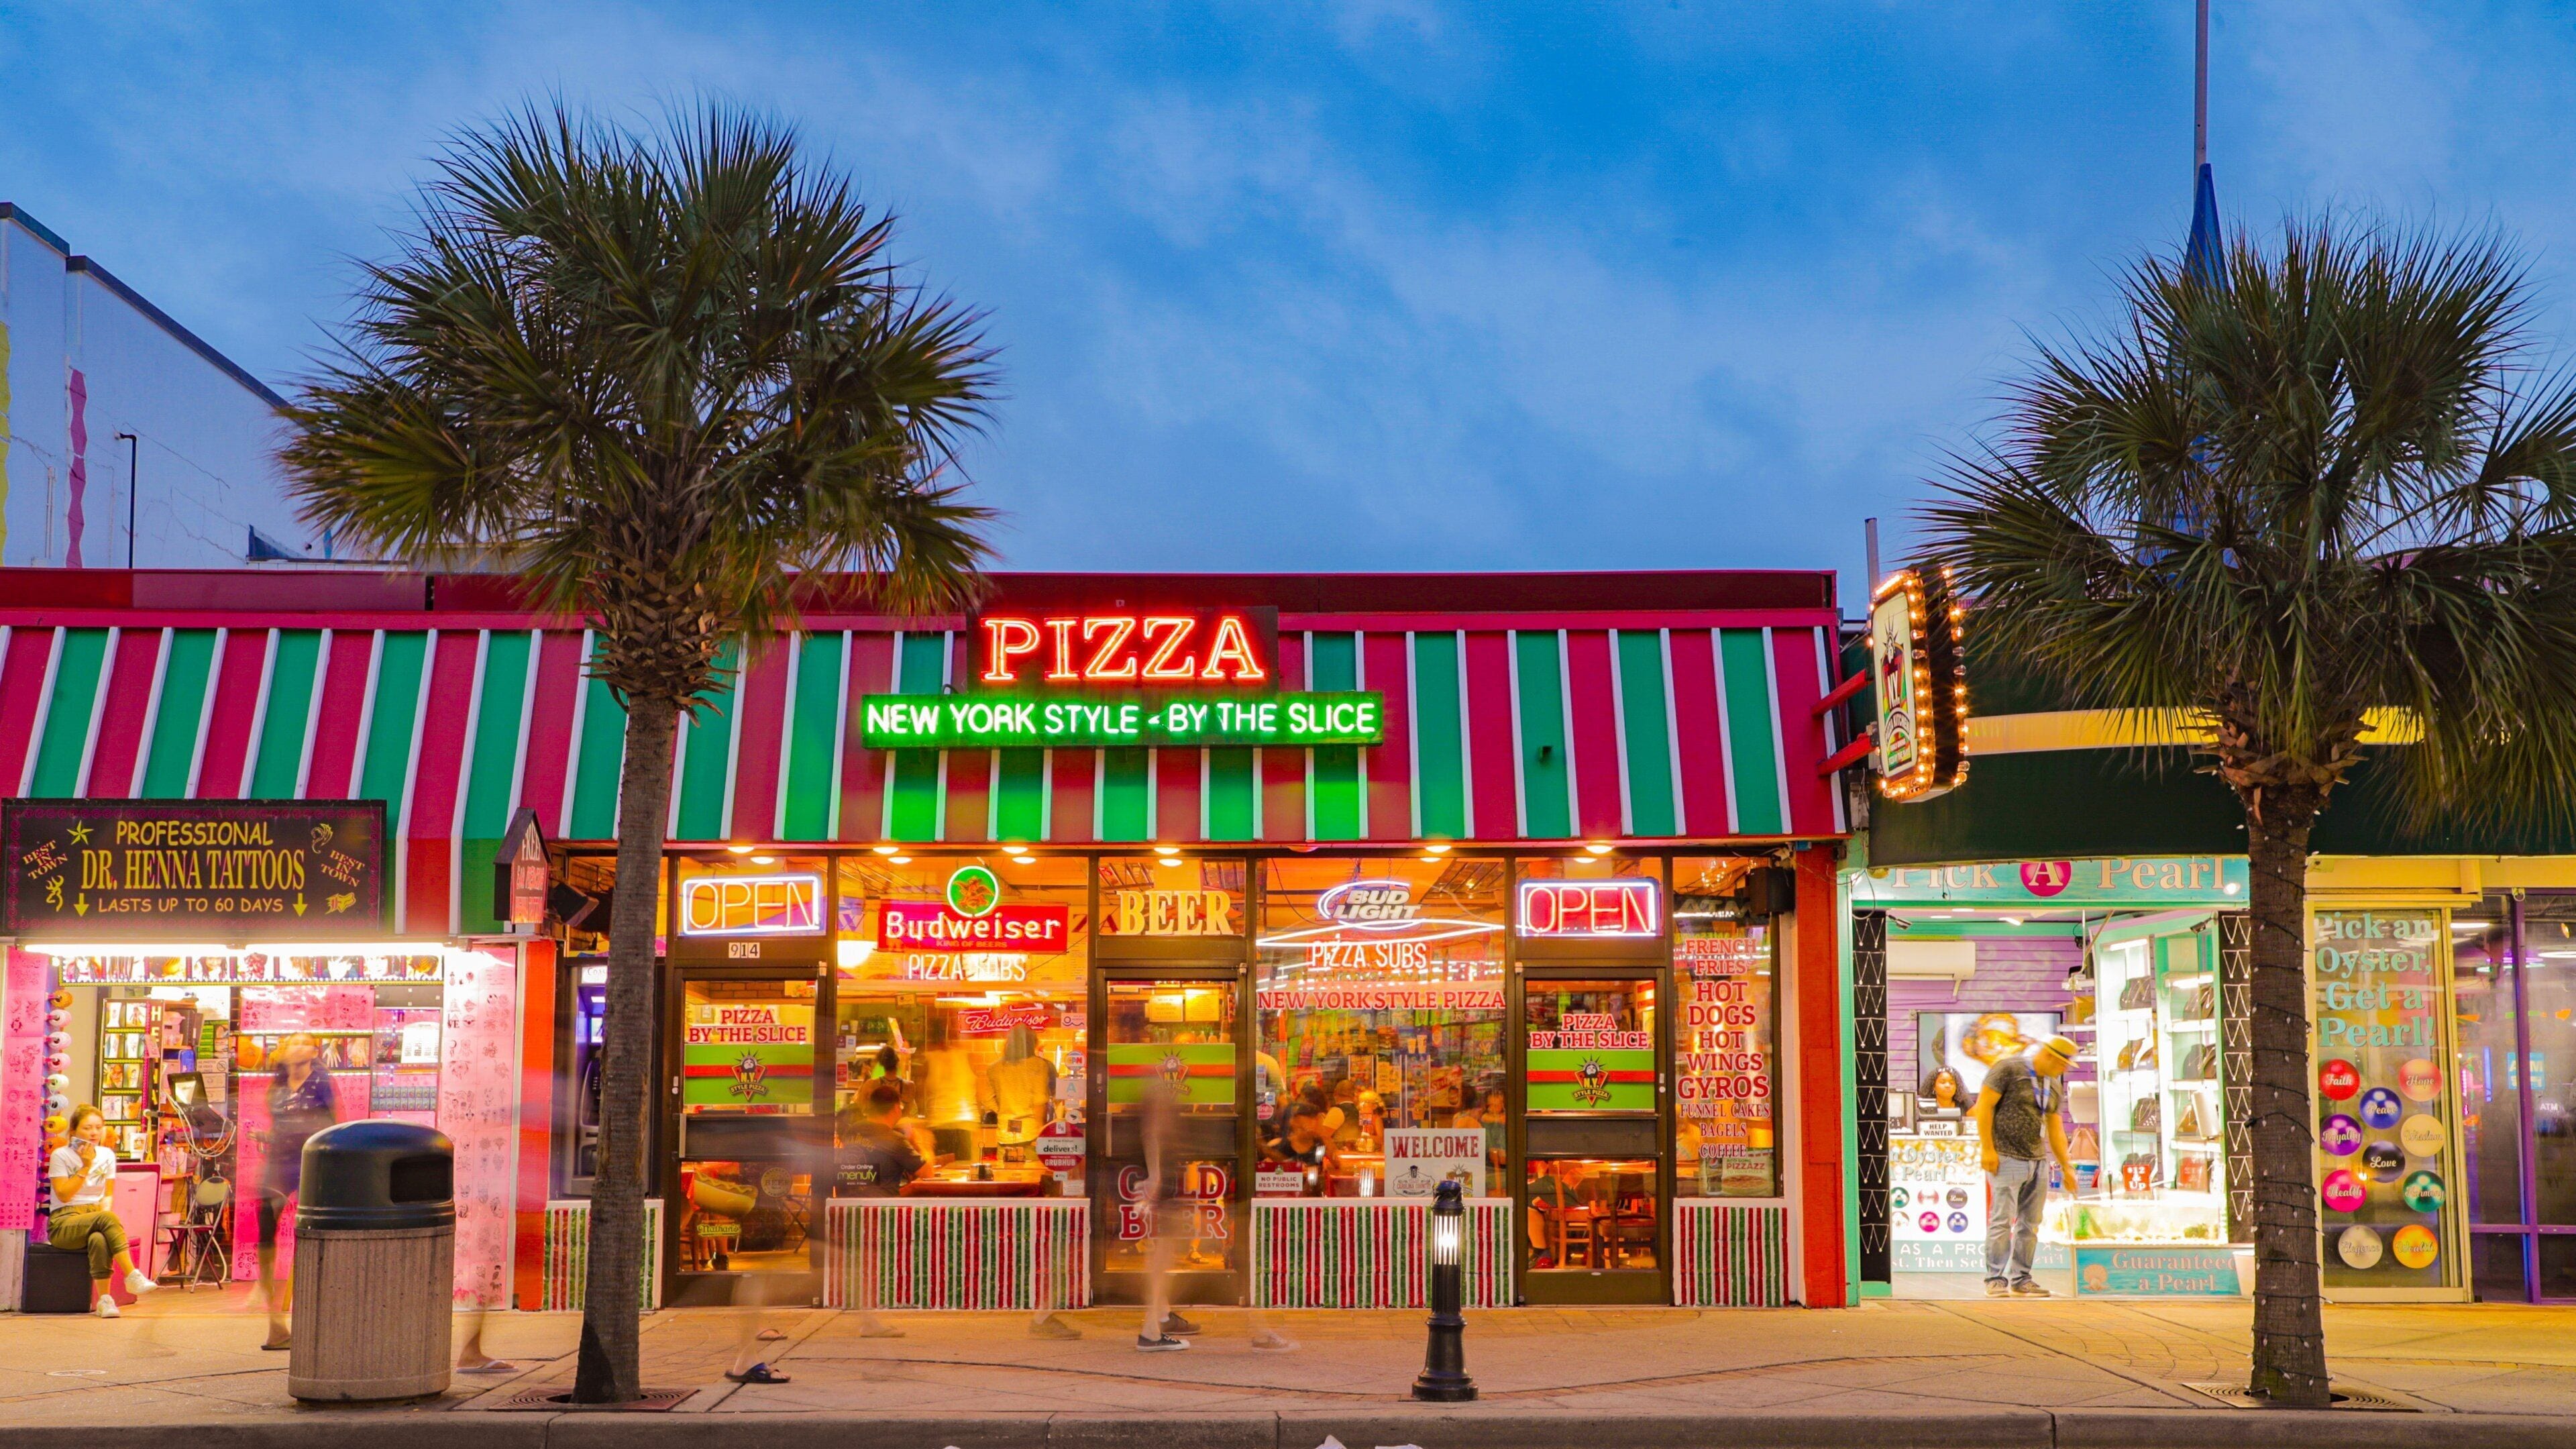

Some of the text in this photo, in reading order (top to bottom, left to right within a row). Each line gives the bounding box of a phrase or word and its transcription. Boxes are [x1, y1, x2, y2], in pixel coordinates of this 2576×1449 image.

[981, 616, 1265, 681] PIZZA
[866, 702, 940, 735] NEW
[949, 702, 1036, 733] YORK
[1044, 704, 1139, 734] STYLE
[1168, 703, 1207, 732] BY
[1215, 702, 1277, 732] THE
[1288, 702, 1375, 734] SLICE
[117, 820, 273, 846] PROFESSIONAL
[22, 841, 57, 865] BEST
[38, 854, 53, 867] IN
[329, 849, 366, 871] BEST
[28, 853, 68, 879] TOWN
[81, 849, 305, 890] DR. HENNA TATTOOS
[336, 862, 350, 873] IN
[2029, 862, 2063, 887] A
[2097, 858, 2226, 890] Pearl
[320, 863, 360, 888] TOWN
[99, 898, 284, 912] LASTS UP TO 60 DAYS
[689, 881, 820, 929] OPEN
[1346, 889, 1409, 905] BUD
[1116, 891, 1234, 935] BEER
[1332, 904, 1422, 920] LIGHT
[1527, 887, 1655, 934] OPEN
[885, 911, 1061, 940] Budweiser
[2314, 912, 2433, 939] Pick an
[730, 944, 759, 957] 914
[1684, 939, 1756, 954] FRENCH
[1311, 941, 1427, 969] PIZZA SUBS
[2316, 947, 2432, 979] Oyster,
[908, 953, 963, 980] PIZZA
[1695, 959, 1748, 975] FRIES
[1696, 981, 1748, 1002] HOT
[2326, 981, 2425, 1010] Get a
[1257, 991, 1307, 1010] NEW
[1443, 991, 1505, 1010] PIZZA
[720, 1009, 775, 1024] PIZZA
[1562, 1014, 1617, 1030] PIZZA
[1688, 1005, 1756, 1026] DOGS
[688, 1027, 806, 1042] BY THE SLICE
[2318, 1016, 2436, 1047] Pearl!
[1530, 1032, 1648, 1048] BY THE SLICE
[1698, 1031, 1744, 1049] HOT
[1686, 1053, 1763, 1071] WINGS
[2509, 1060, 2543, 1071] AM
[741, 1072, 757, 1083] N.Y.
[1164, 1072, 1179, 1082] N.Y.
[1584, 1078, 1599, 1088] N.Y.
[2325, 1074, 2353, 1085] Faith
[2406, 1075, 2434, 1089] Hope
[730, 1084, 748, 1093] STYLE
[1067, 1083, 1076, 1092] A
[1592, 1089, 1609, 1097] PIZZA
[1677, 1075, 1770, 1099] GYROS
[1680, 1103, 1770, 1118] FUNNEL CAKES
[2367, 1104, 2398, 1114] Peace
[1700, 1123, 1747, 1137] BAGELS
[1391, 1136, 1479, 1158] WELCOME
[1700, 1144, 1746, 1158] COFFEE
[1902, 1148, 1960, 1166] Oyster
[2370, 1156, 2397, 1168] Love
[837, 1170, 876, 1182] menufy
[1902, 1165, 1946, 1181] Pearl
[1118, 1165, 1226, 1201] CLD
[2129, 1181, 2146, 1190] Up
[2327, 1185, 2363, 1197] Health
[1900, 1244, 1921, 1255] AS
[1933, 1244, 1943, 1254] A
[1916, 1256, 1954, 1268] Then
[2139, 1274, 2216, 1291] a Pearl
